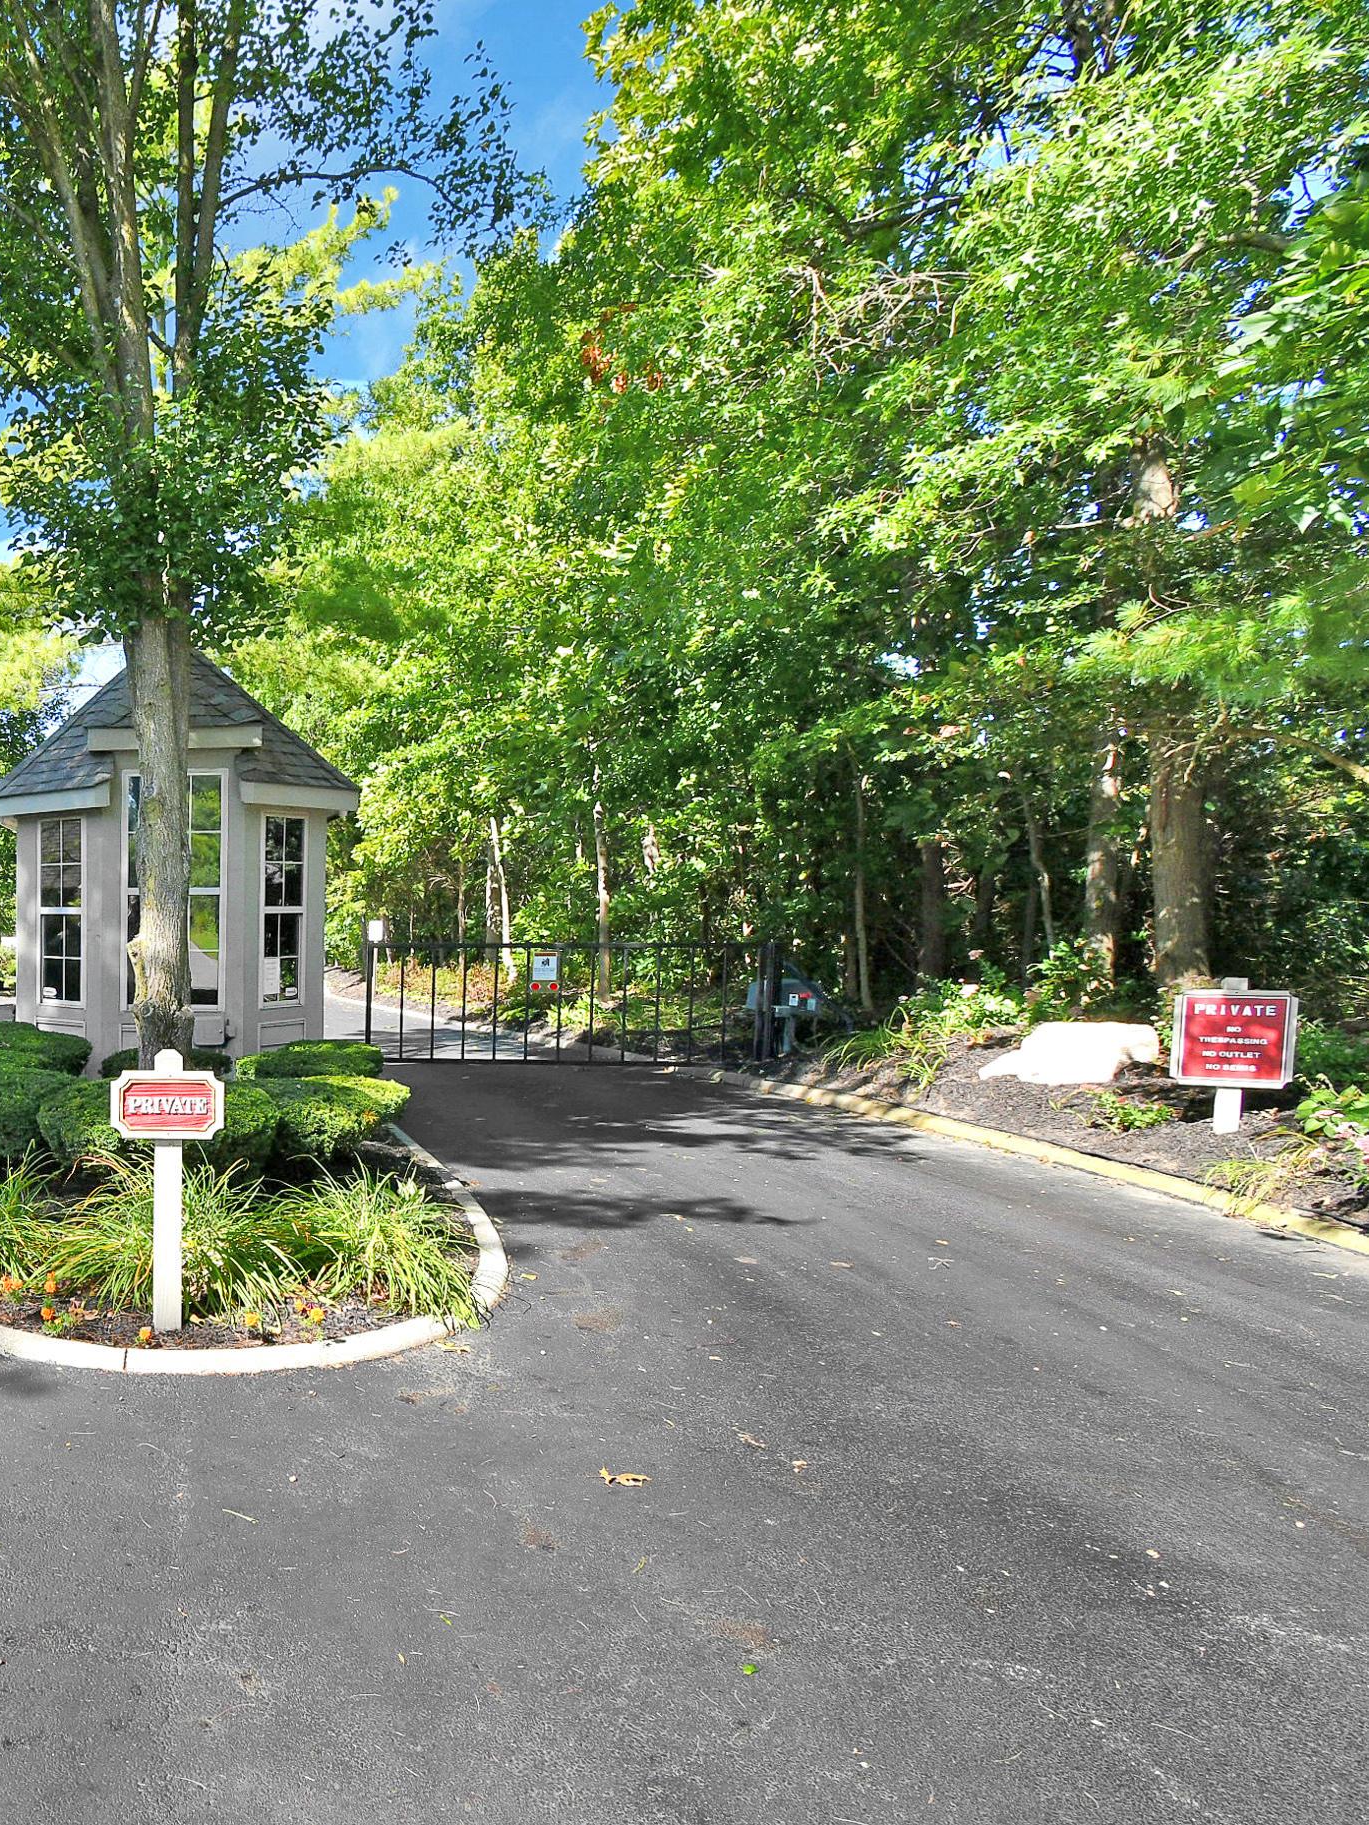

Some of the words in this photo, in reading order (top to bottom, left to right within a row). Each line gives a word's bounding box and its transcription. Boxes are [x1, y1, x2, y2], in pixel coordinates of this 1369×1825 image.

[1194, 1003, 1277, 1016] PRIVATE
[1198, 1036, 1268, 1045] TRESPASSING
[1202, 1050, 1216, 1058] NO
[1219, 1051, 1261, 1059] OUTLET
[1205, 1063, 1220, 1071] NO
[127, 1096, 208, 1115] PRIVATE
